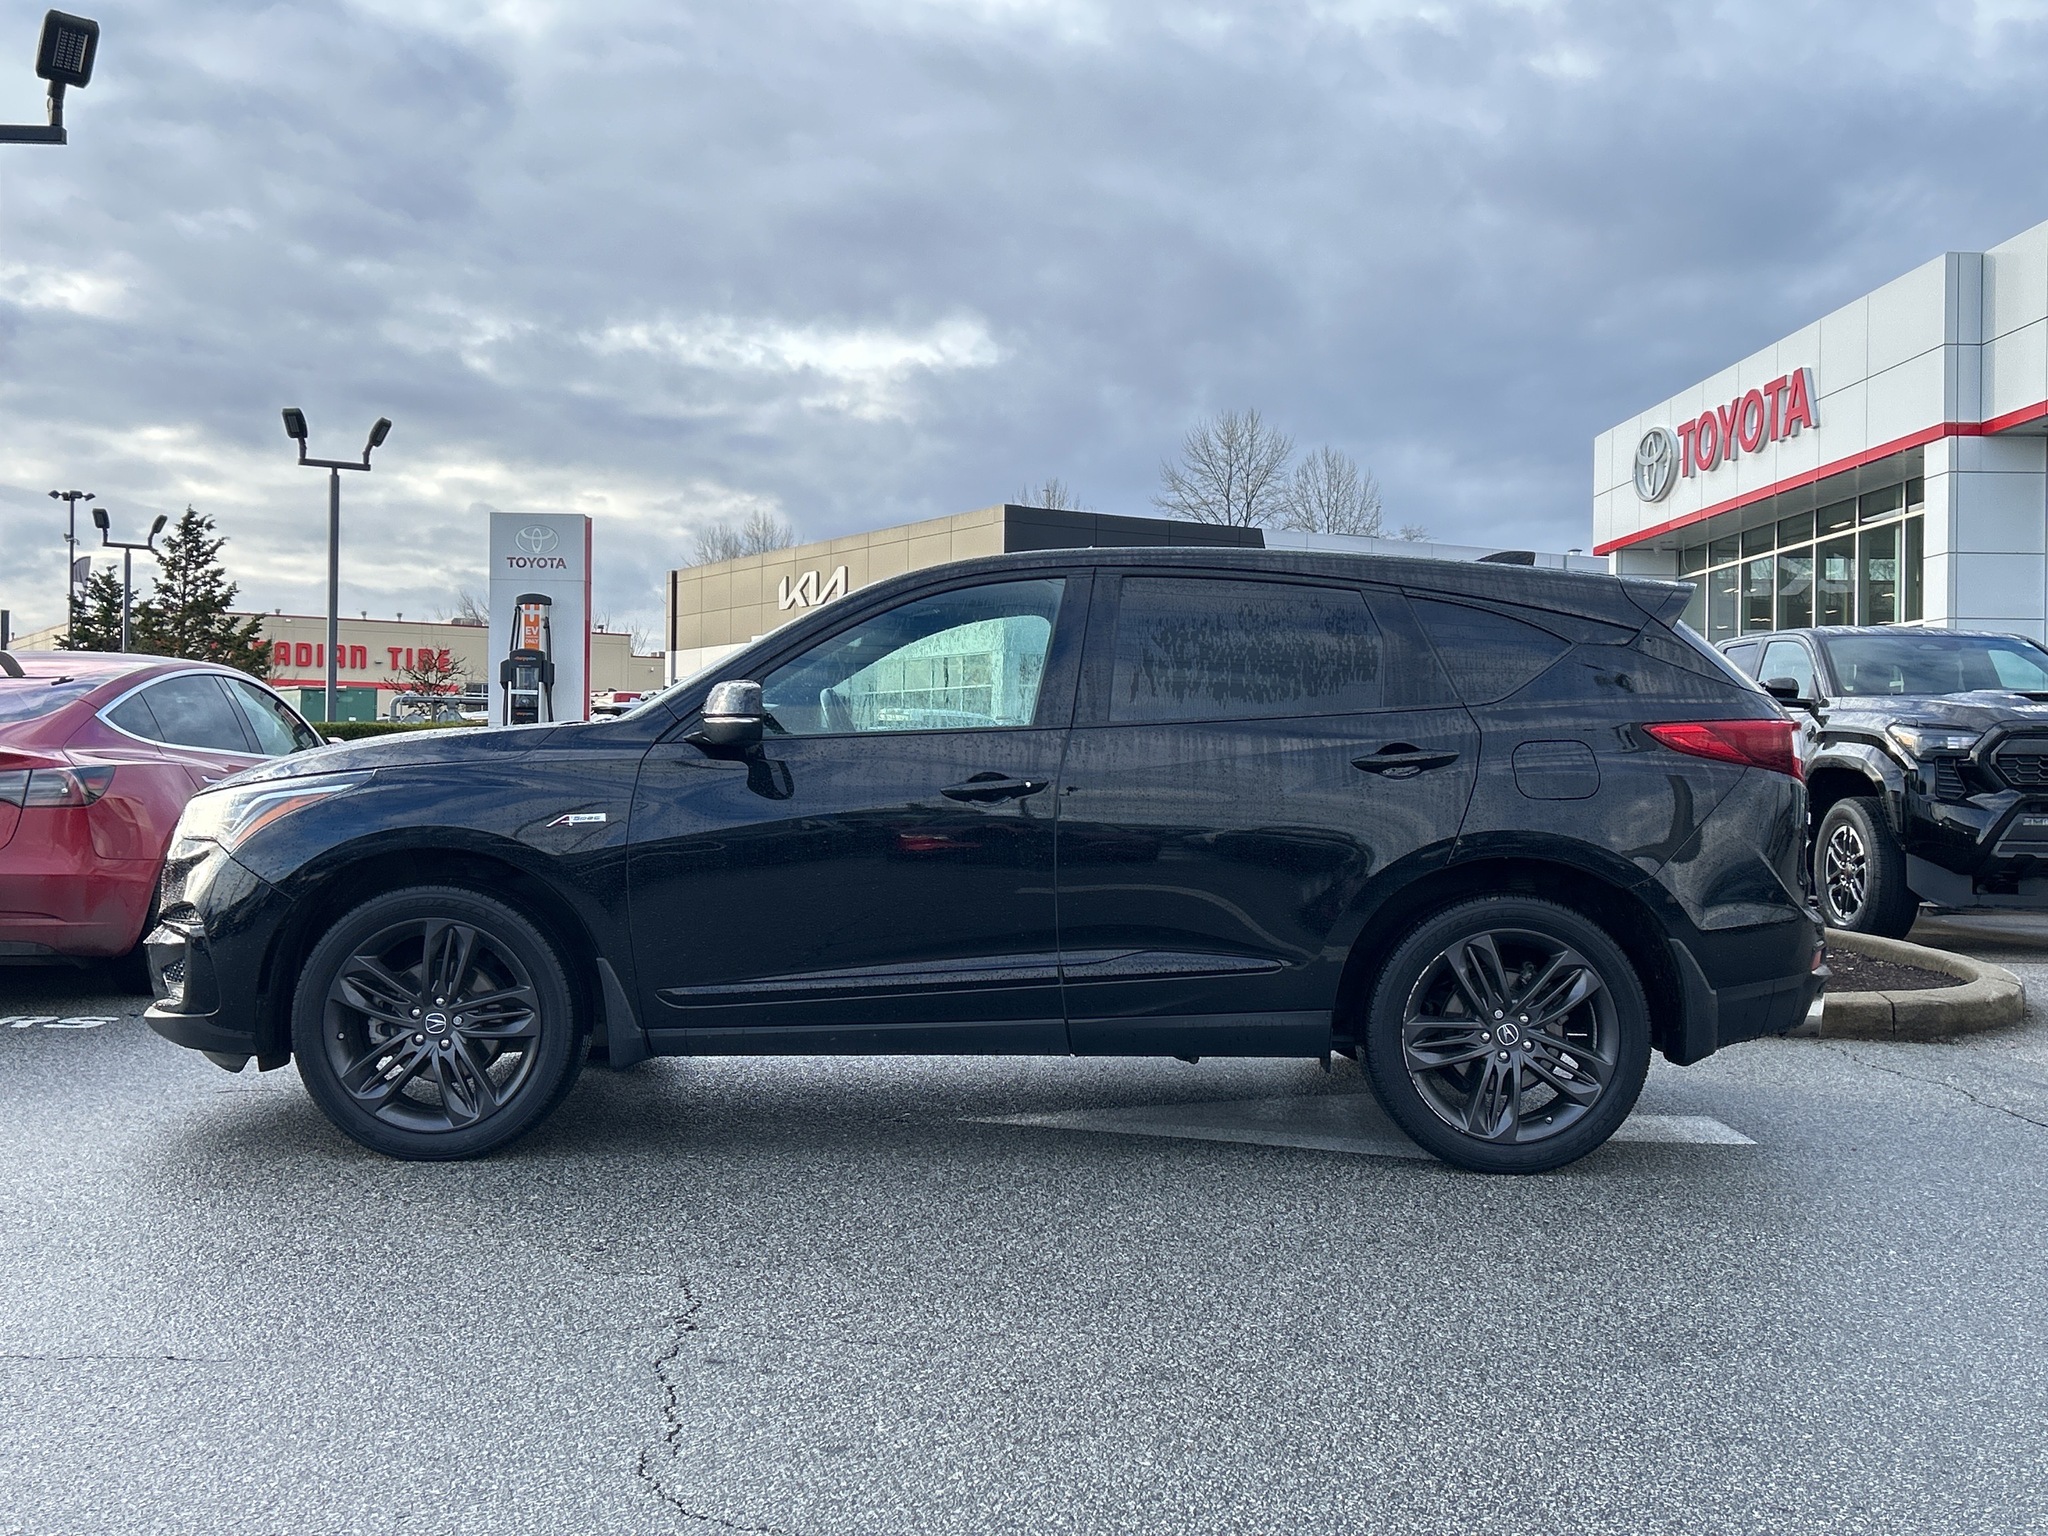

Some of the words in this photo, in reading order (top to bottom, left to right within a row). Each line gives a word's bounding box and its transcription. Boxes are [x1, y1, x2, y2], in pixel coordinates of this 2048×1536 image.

[1677, 367, 1815, 479] TOYOTA
[506, 557, 567, 569] TOYOTA
[779, 565, 848, 611] KIA
[525, 626, 539, 635] EV
[387, 647, 450, 672] TIRE
